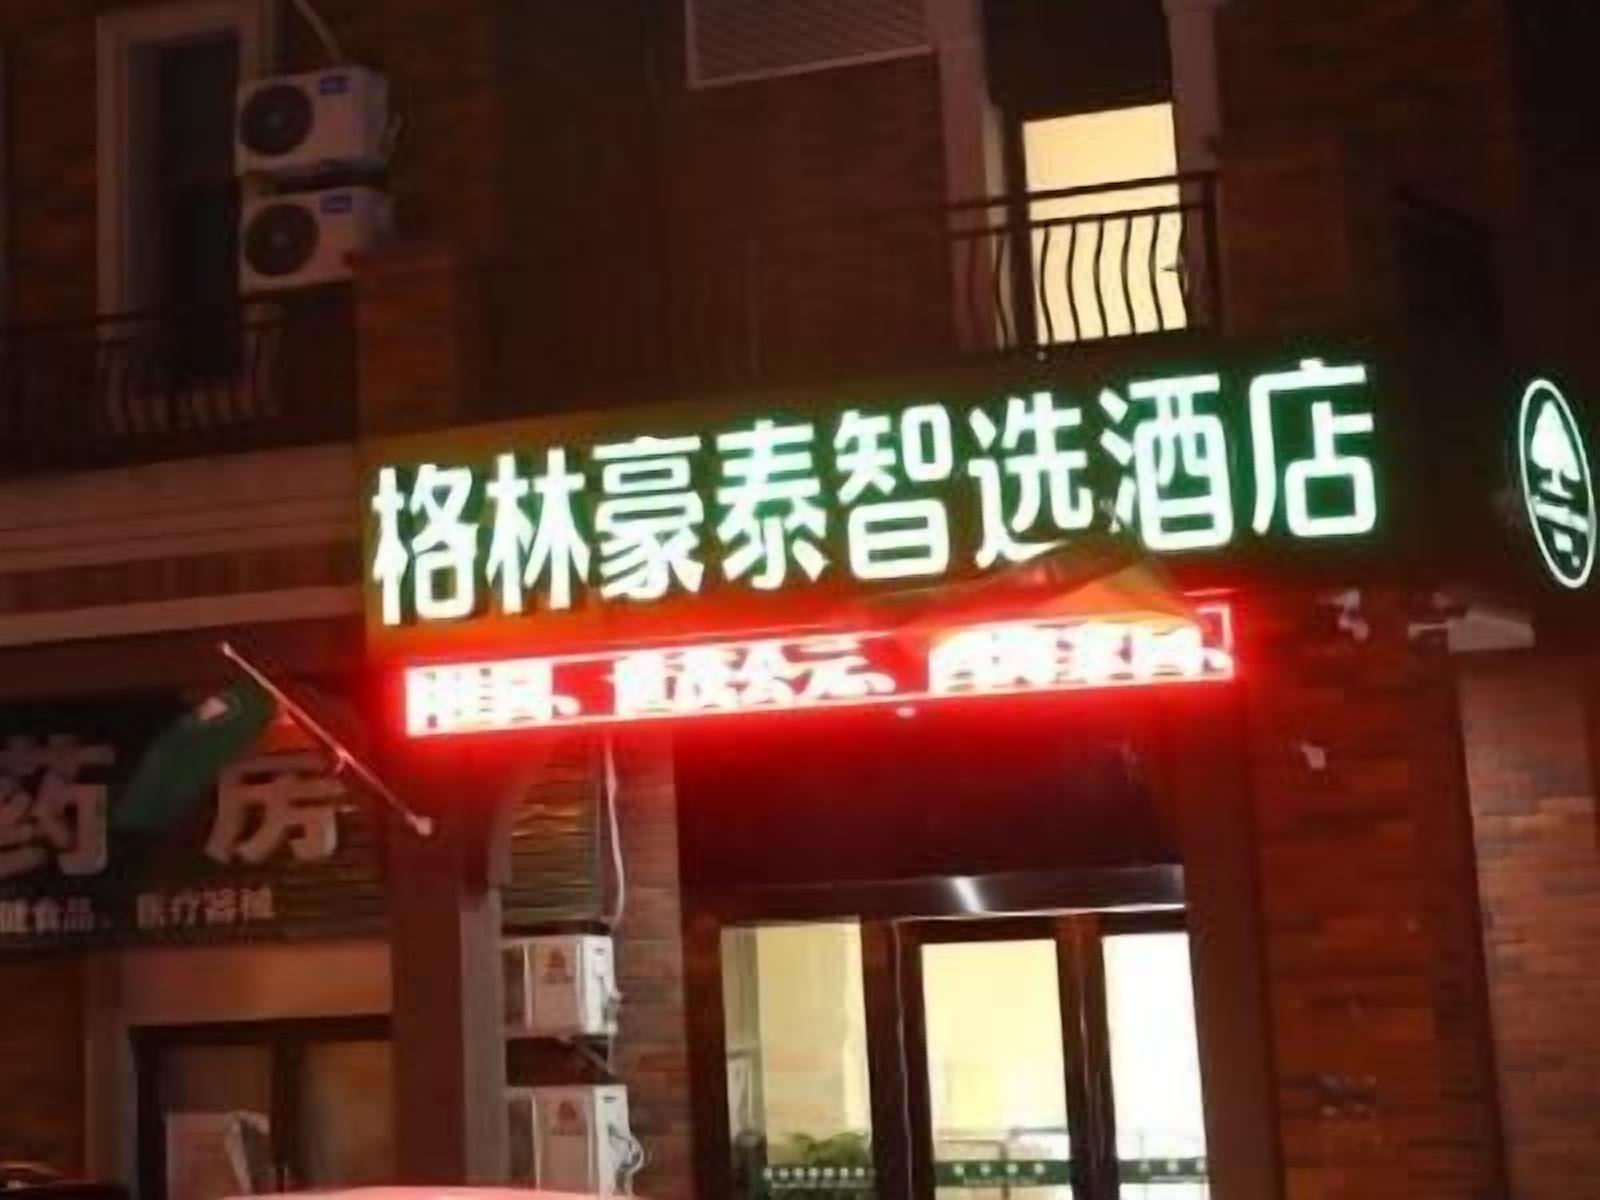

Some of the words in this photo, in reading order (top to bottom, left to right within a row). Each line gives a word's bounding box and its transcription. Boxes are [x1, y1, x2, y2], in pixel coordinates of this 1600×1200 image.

[371, 358, 1378, 626] 格林豪泰智选酒店
